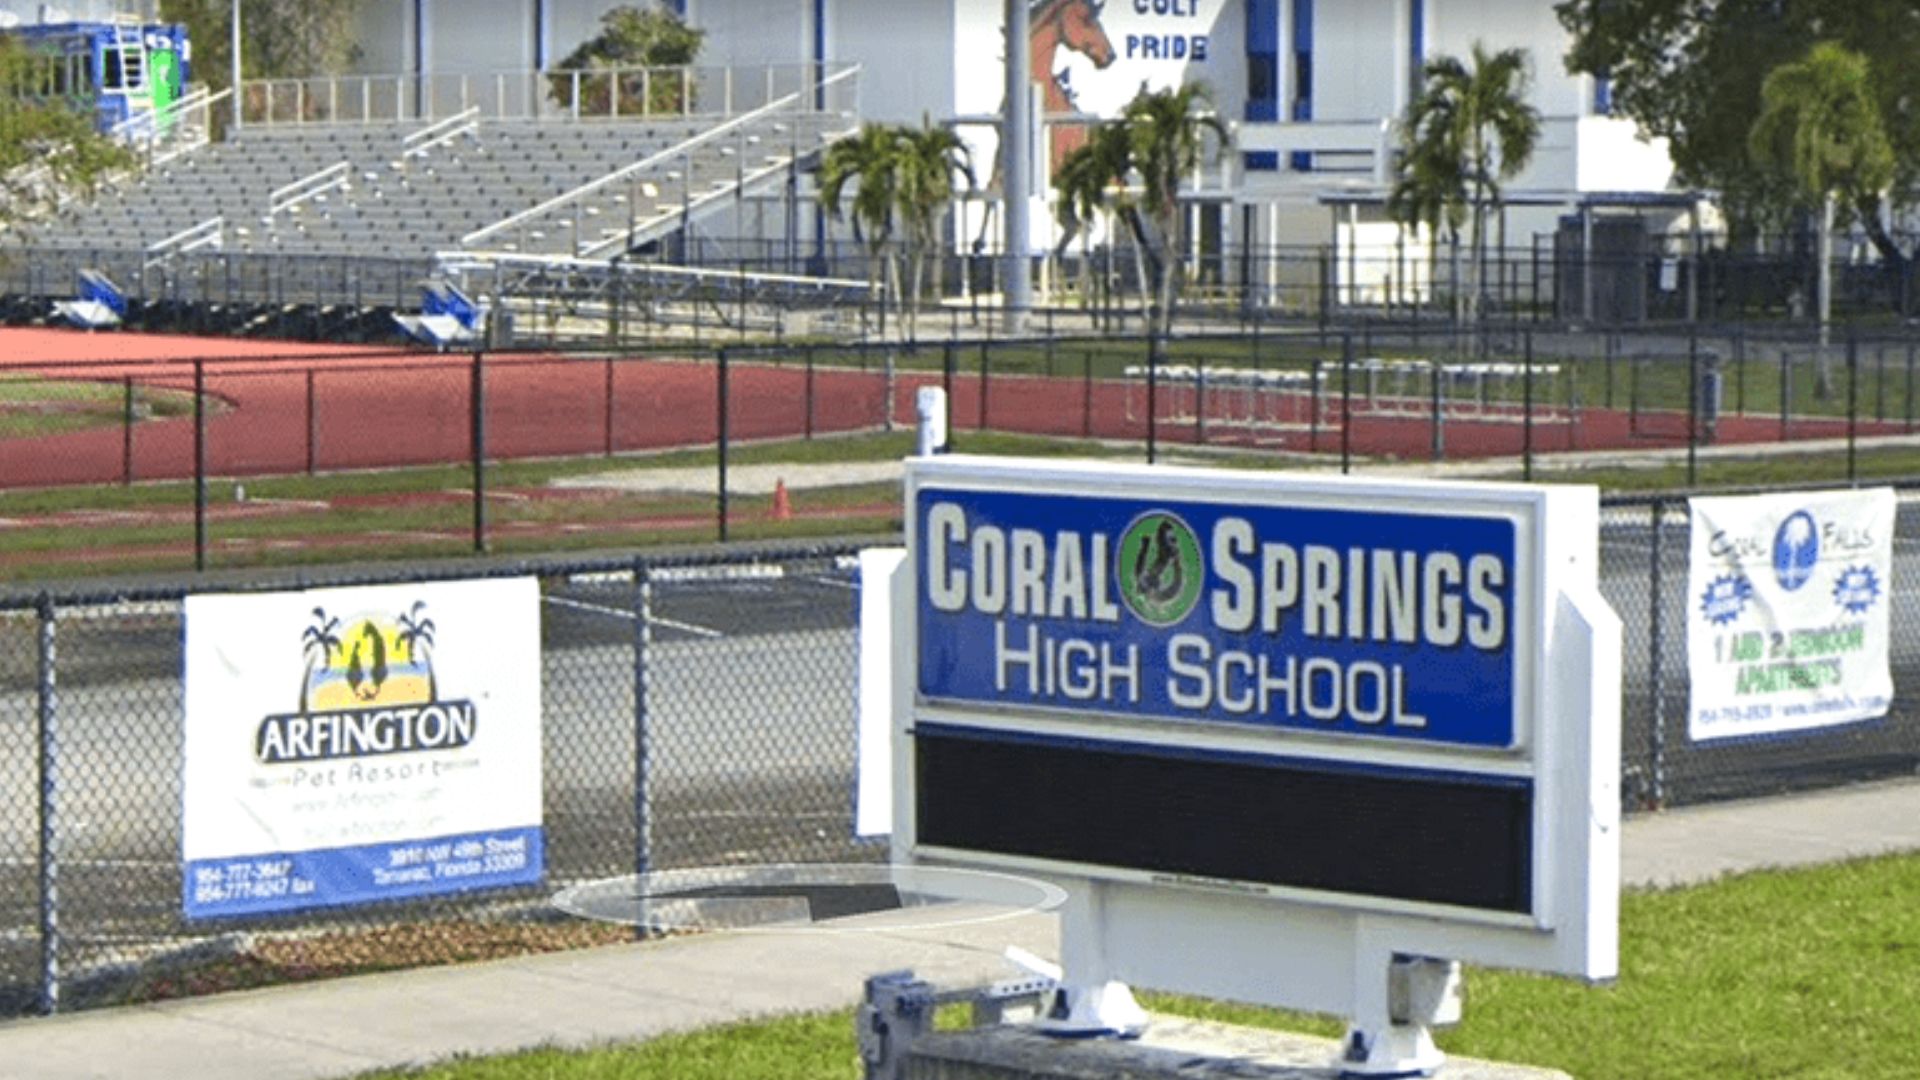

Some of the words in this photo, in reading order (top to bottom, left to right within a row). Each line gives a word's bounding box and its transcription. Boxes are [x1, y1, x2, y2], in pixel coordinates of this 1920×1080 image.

[1134, 0, 1197, 16] COLT
[1126, 34, 1207, 61] PRIDE
[928, 502, 1119, 622] CORAL
[1211, 517, 1505, 650] SPRINGS
[1769, 631, 1785, 659] 2
[995, 621, 1139, 702] HIGH
[1167, 633, 1427, 728] SCHOOL
[260, 705, 473, 760] ARFINGTON
[292, 768, 337, 788] Pet
[348, 759, 441, 785] Resort
